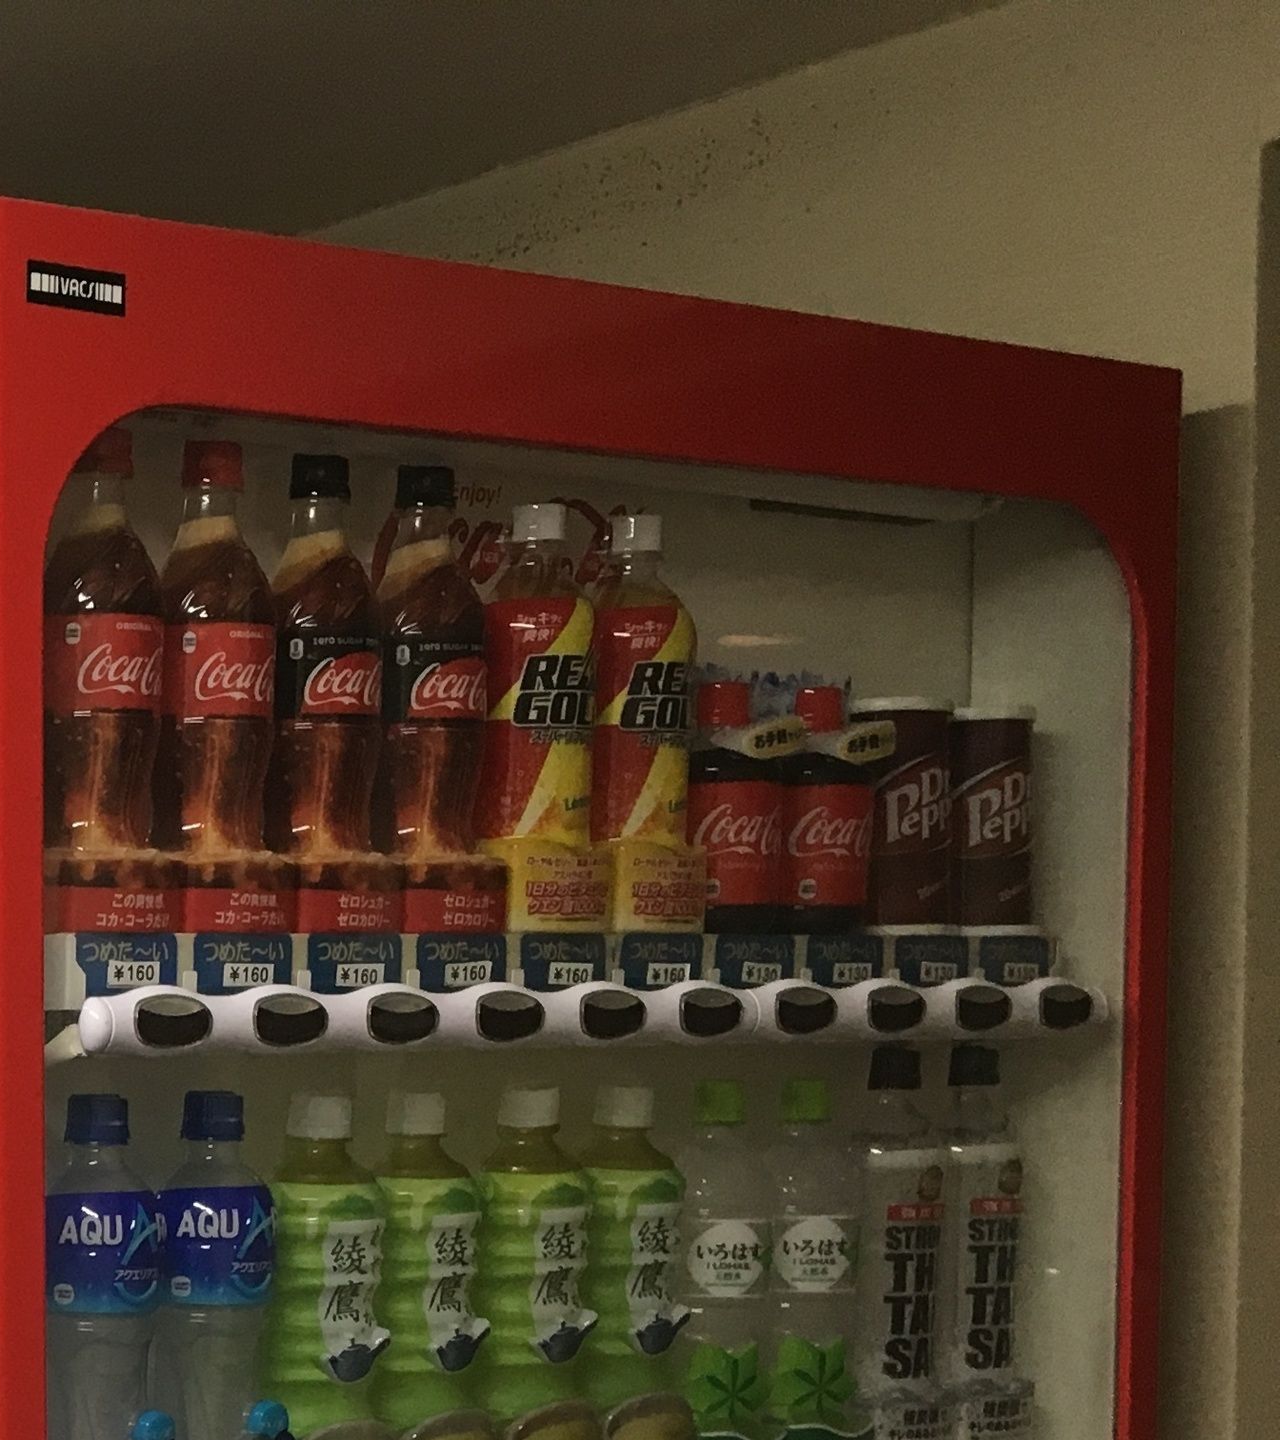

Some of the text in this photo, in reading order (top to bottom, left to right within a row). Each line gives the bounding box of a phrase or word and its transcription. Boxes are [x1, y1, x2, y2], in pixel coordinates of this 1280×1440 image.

[60, 276, 95, 299] VACS
[114, 965, 154, 981] ¥160
[230, 967, 268, 983] ¥160
[341, 969, 378, 985] ¥160
[451, 966, 487, 981] ¥160
[553, 967, 589, 983] ¥160
